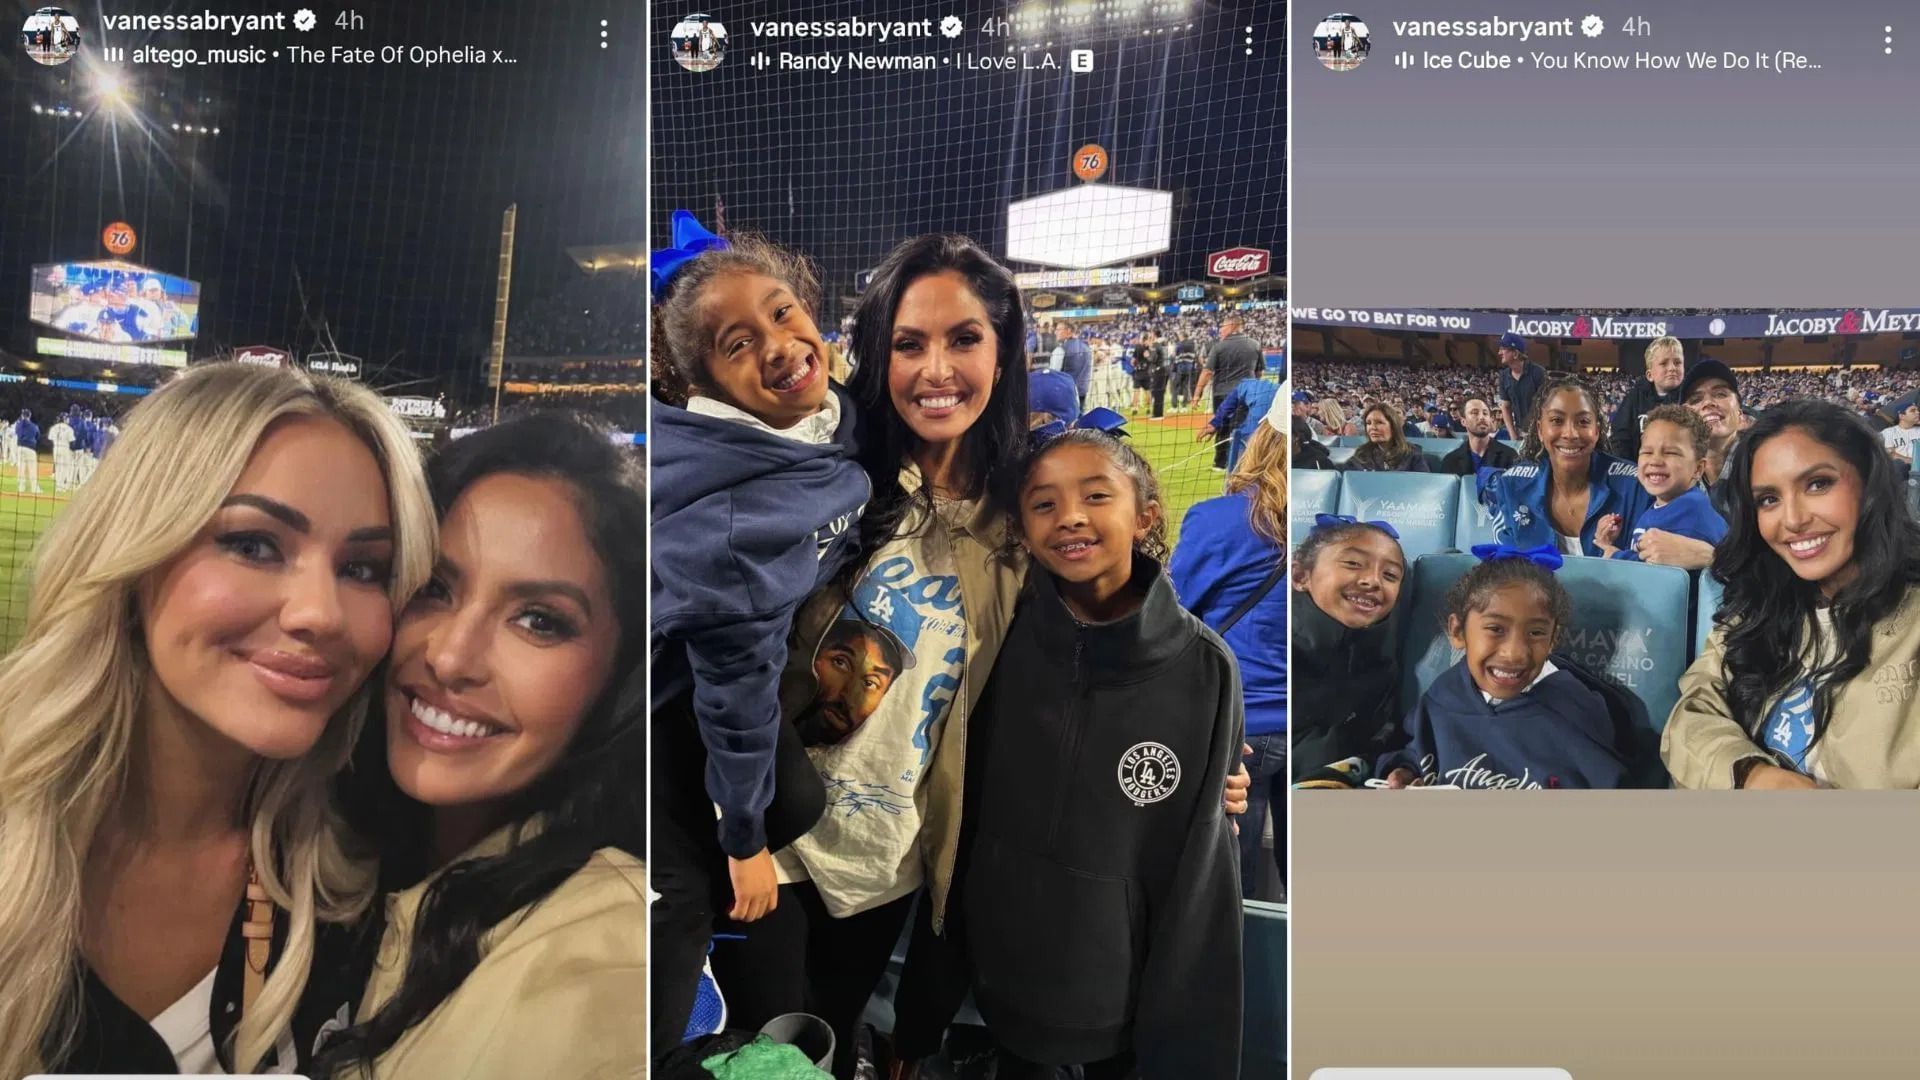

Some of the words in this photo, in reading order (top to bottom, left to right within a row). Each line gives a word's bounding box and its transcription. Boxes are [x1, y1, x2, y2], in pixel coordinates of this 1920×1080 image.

[1081, 155, 1100, 170] 76
[111, 232, 129, 246] 76
[1291, 308, 1318, 320] WE
[1323, 309, 1346, 322] GO
[1350, 310, 1370, 323] TO
[1374, 312, 1403, 325] BAT
[1407, 315, 1437, 328] FOR
[1440, 316, 1471, 329] YOU
[869, 585, 895, 624] LA
[1584, 652, 1655, 671] CASINO
[1772, 711, 1793, 748] LA
[1124, 751, 1141, 770] LOS
[1143, 747, 1176, 780] ANGELES
[1139, 761, 1157, 786] LA
[1123, 776, 1169, 799] DODGERS
